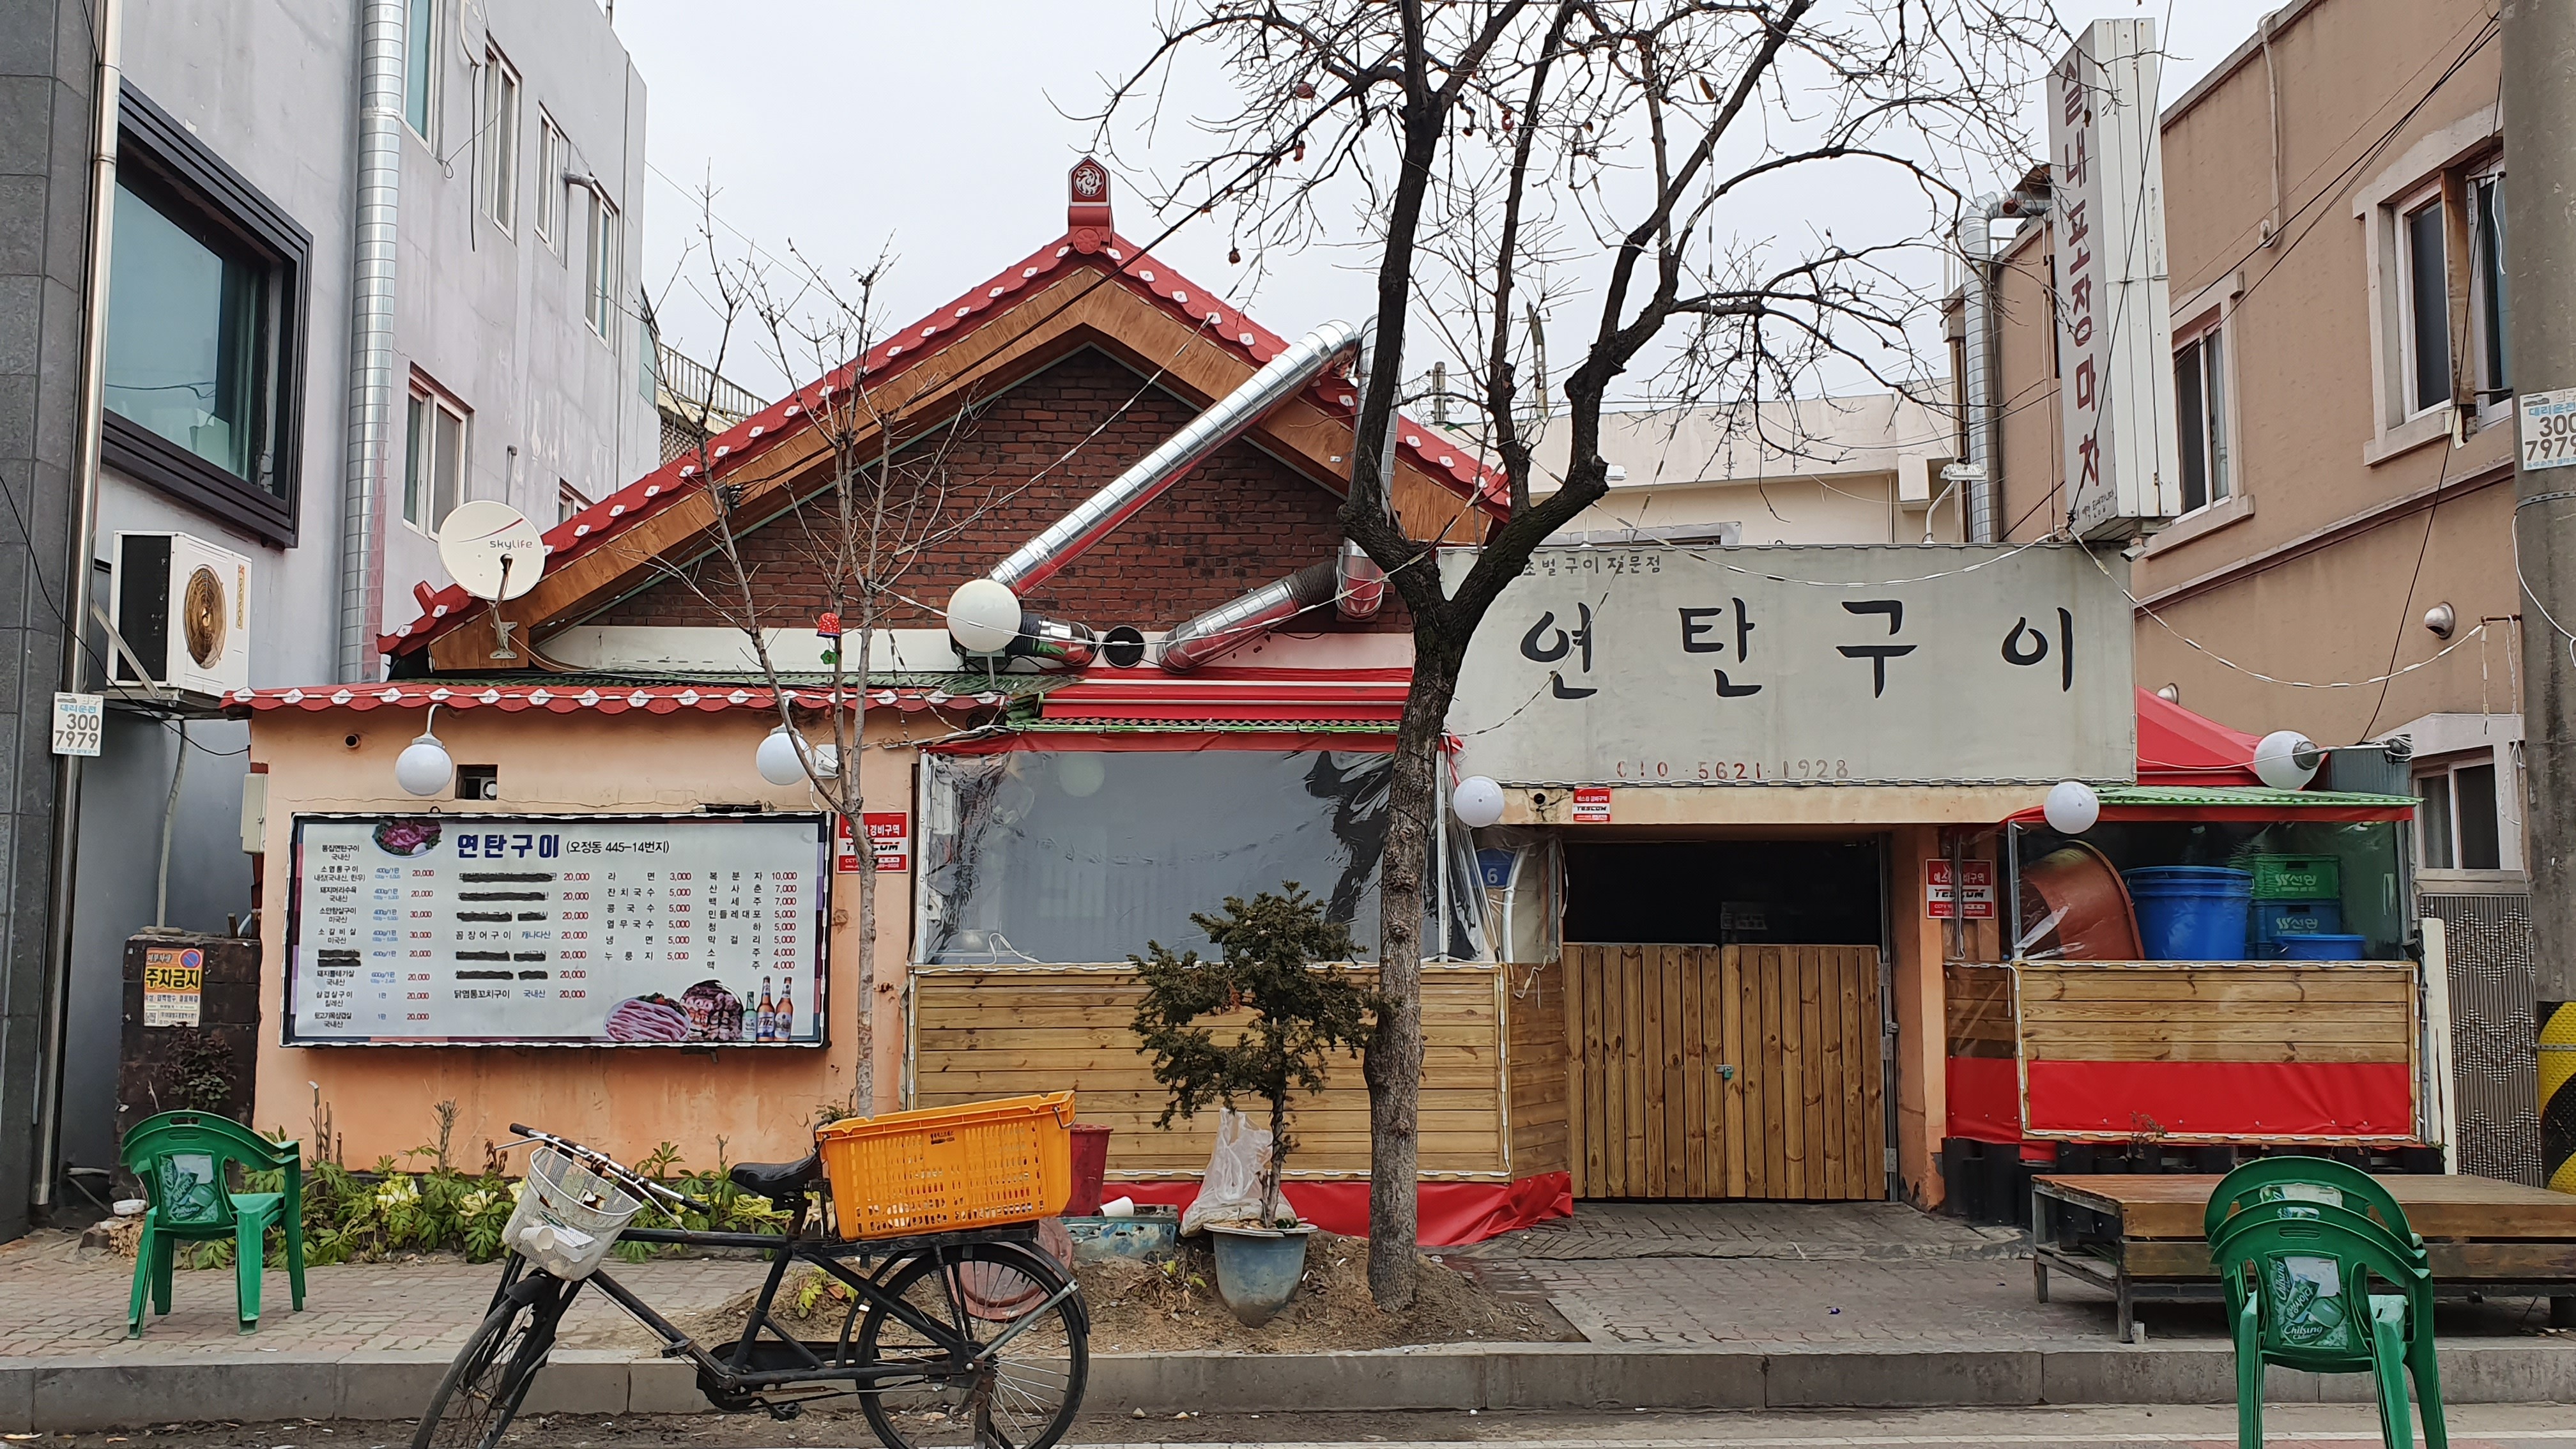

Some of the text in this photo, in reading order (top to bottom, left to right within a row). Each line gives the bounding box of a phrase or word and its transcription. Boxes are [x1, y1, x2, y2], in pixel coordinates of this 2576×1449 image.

[490, 540, 533, 550] skylife
[1565, 557, 1599, 574] 구이
[1521, 596, 2073, 700] 연탄구이
[66, 713, 99, 731] 300
[55, 730, 98, 749] 7979
[1698, 760, 1761, 779] 5621
[1783, 759, 1848, 778] 1928
[870, 824, 900, 836] 경비구역
[457, 834, 670, 858] 연탄구이 (오정동 445-14번지)
[564, 873, 590, 882] 20,000
[670, 873, 691, 881] 3,000
[771, 872, 797, 881] 10,000
[1487, 868, 1498, 884] 6
[669, 889, 691, 897] 5,000
[775, 884, 797, 893] 7,000
[563, 892, 589, 901] 20,000
[775, 897, 797, 906] 7,000
[668, 904, 691, 913] 5,000
[562, 912, 588, 921] 20,000
[774, 910, 796, 919] 5,000
[668, 920, 690, 929] 5,000
[774, 923, 796, 931] 5,000
[561, 931, 587, 940] 20,000
[668, 935, 690, 945] 5,000
[774, 935, 795, 944] 5,000
[560, 951, 586, 960] 20,000
[667, 952, 689, 961] 5,000
[773, 948, 795, 957] 4,000
[773, 961, 795, 970] 4,000
[146, 968, 199, 988] 주차금지
[560, 970, 586, 979] 20,000
[454, 990, 586, 999] 닭염통꼬치구이 국내산 20,000
[2283, 1324, 2323, 1335] Chilsung
